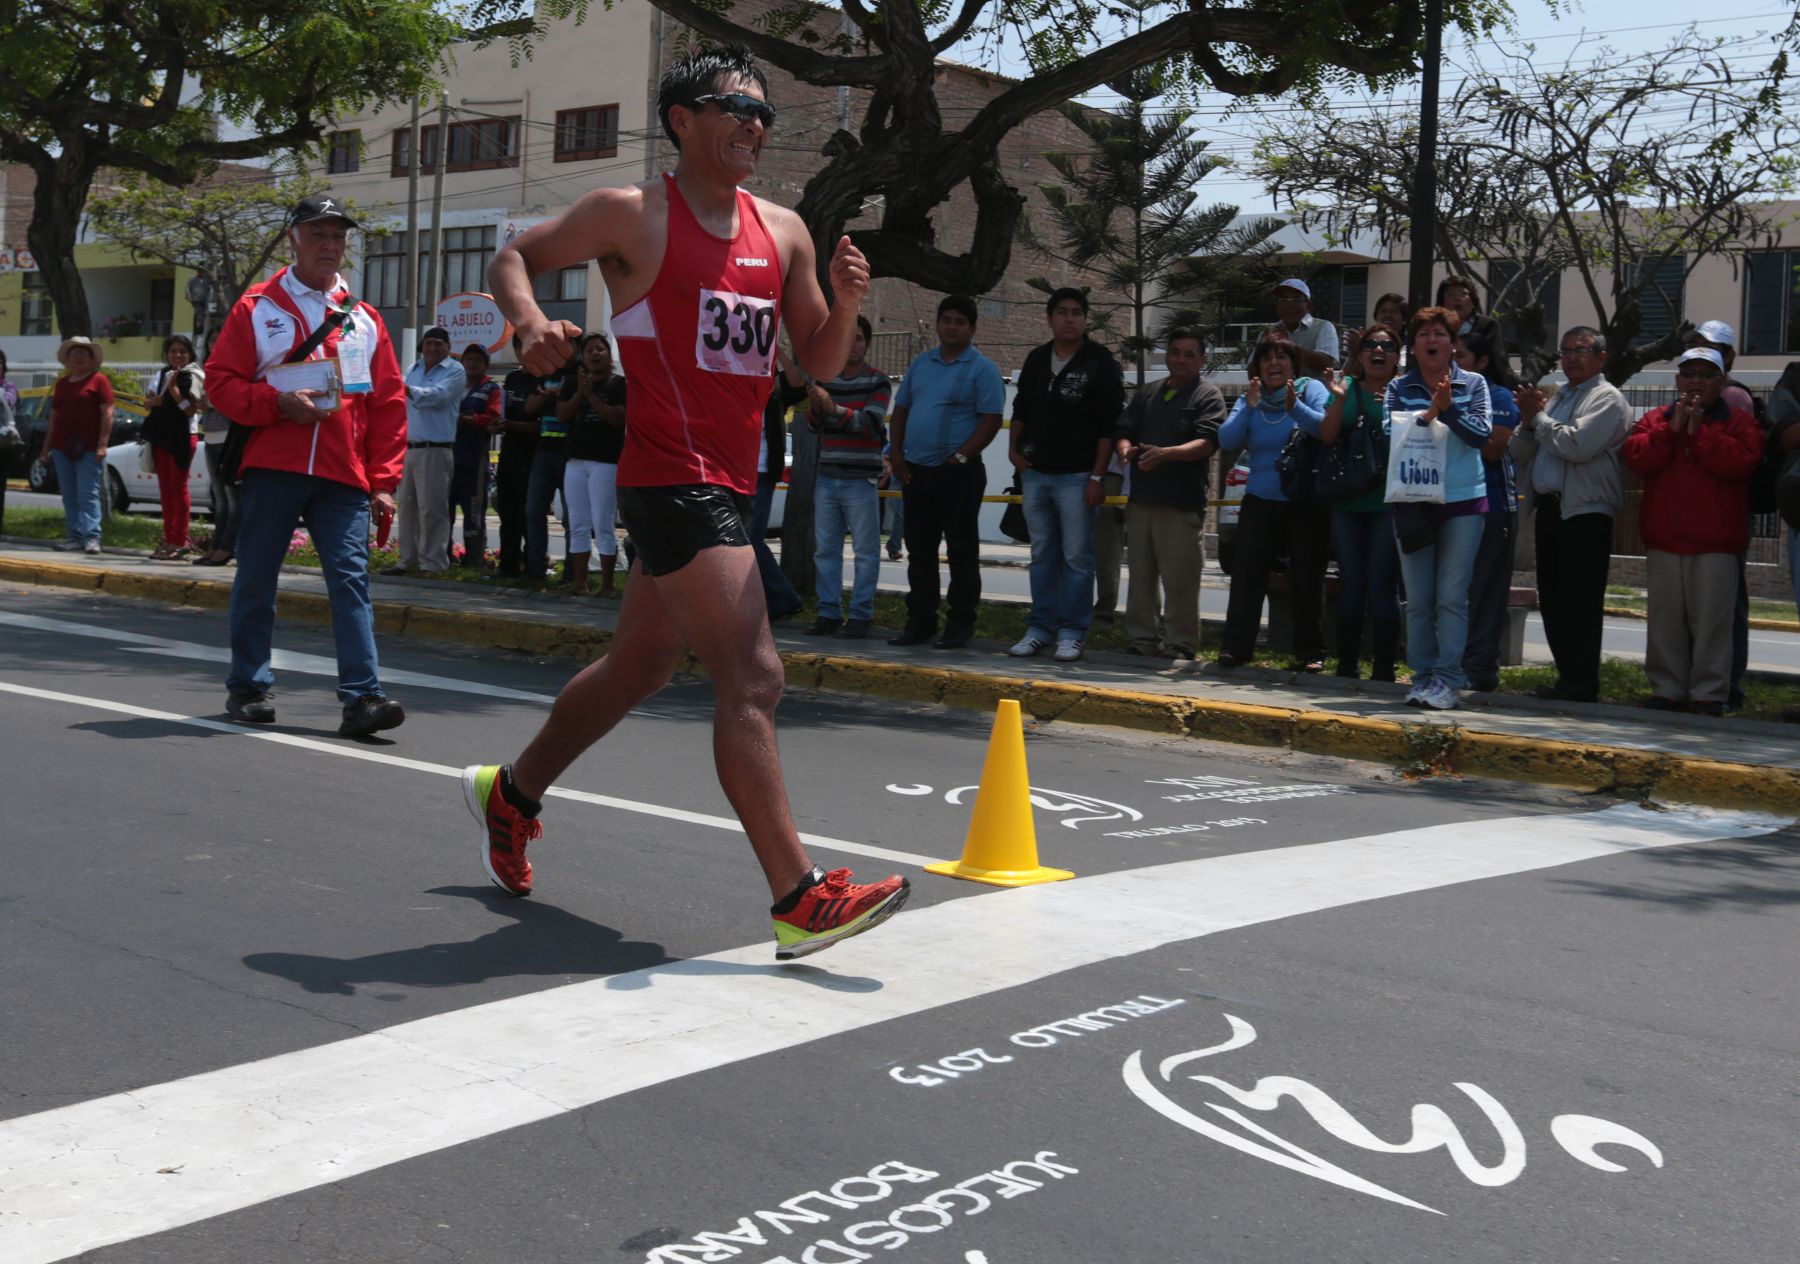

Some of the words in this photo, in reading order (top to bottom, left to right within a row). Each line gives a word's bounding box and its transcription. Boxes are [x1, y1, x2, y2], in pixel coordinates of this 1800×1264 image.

[735, 257, 769, 267] PERU
[437, 315, 448, 327] EL
[451, 312, 494, 327] ABUELO
[703, 297, 775, 357] 330
[1400, 458, 1440, 485] Libun
[1103, 824, 1210, 839] TRUJILLO
[1206, 817, 1268, 828] 2013
[1010, 995, 1186, 1047] TRUJILLO
[889, 1048, 1014, 1086] 2013
